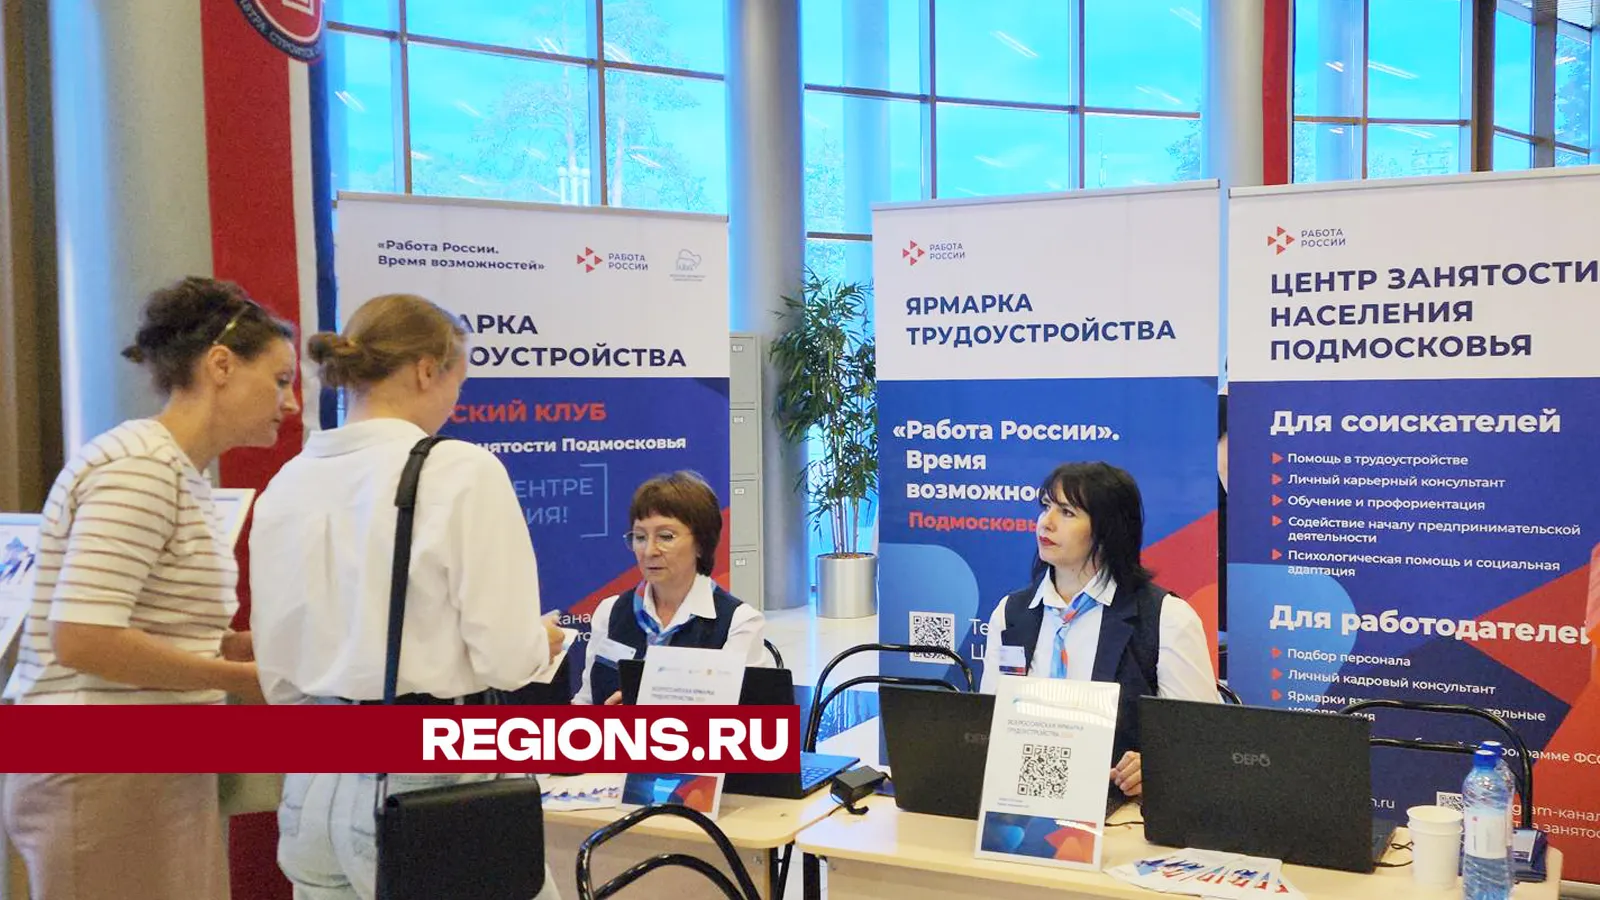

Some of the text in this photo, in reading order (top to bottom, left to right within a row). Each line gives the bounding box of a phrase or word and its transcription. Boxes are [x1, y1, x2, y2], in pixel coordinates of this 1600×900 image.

[1301, 228, 1343, 238] РАБОТА
[378, 240, 499, 254] «Работа России.
[930, 242, 963, 252] РАБОТА
[1301, 238, 1346, 248] РОССИИ
[378, 255, 545, 271] Время возможностей»
[608, 253, 646, 262] РАБОТА
[930, 251, 965, 260] РОССИИ
[608, 262, 648, 271] РОССИИ
[1272, 260, 1599, 297] ЦЕНТР ЗАНЯТОСТИ
[906, 293, 1033, 315] ЯРМАРКА
[1271, 301, 1473, 327] НАСЕЛЕНИЯ
[459, 314, 538, 334] АРКА
[906, 317, 1176, 347] ТРУДОУСТРОЙСТВА
[470, 342, 686, 367] ОУСТРОЙСТВА
[1271, 334, 1531, 363] ПОДМОСКОВЬЯ
[450, 399, 606, 423] СКИЙ КЛУБ
[893, 419, 1120, 441] «Работа России».
[1271, 408, 1561, 436] Для соискателей
[562, 438, 687, 453] Подмосковья
[907, 450, 986, 474] Время
[1288, 453, 1468, 468] Помощь в трудоустройстве
[513, 477, 593, 498] ЕНТРЕ
[1288, 474, 1505, 490] Личный карьерный консультант
[907, 483, 1040, 502] возможно
[1288, 496, 1485, 511] Обучение и профориентация
[908, 511, 1037, 532] Подмосковь
[1288, 516, 1581, 536] Содействие началу предпринимательской
[1288, 532, 1377, 544] деятельности
[1288, 550, 1560, 572] Психологическая помощь и социальная
[1288, 566, 1355, 578] адаптация
[1270, 604, 1331, 630] Для
[1288, 648, 1411, 667] Подбор персонала
[1288, 669, 1496, 695] Личный кадровый консультант
[1288, 690, 1345, 705] Ярмарки
